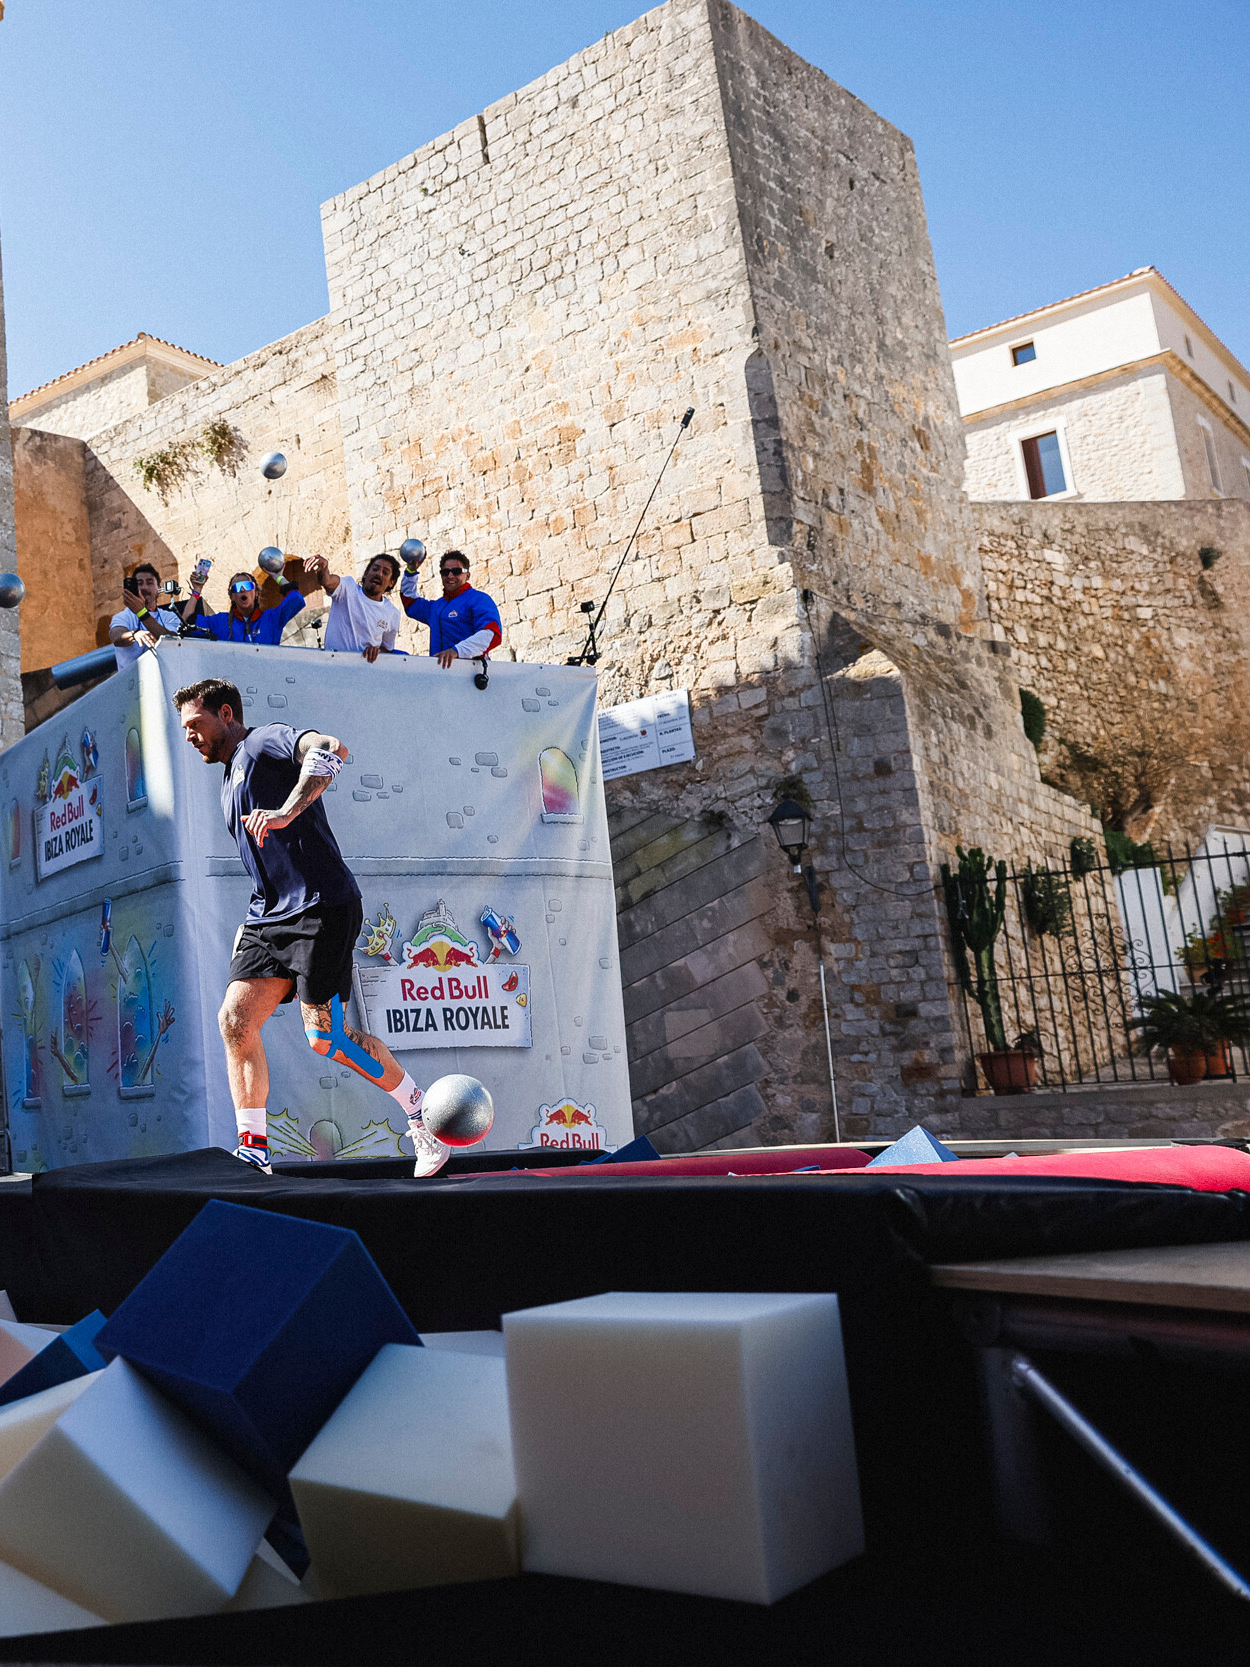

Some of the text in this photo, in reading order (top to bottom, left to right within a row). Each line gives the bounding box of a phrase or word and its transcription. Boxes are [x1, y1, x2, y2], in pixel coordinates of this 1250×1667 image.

[50, 794, 84, 832] Red Bull
[44, 819, 94, 863] IBIZA ROYALE
[400, 975, 489, 1001] Red Bull
[386, 1005, 510, 1033] IBIZA ROYALE
[540, 1132, 600, 1150] Red Bull
